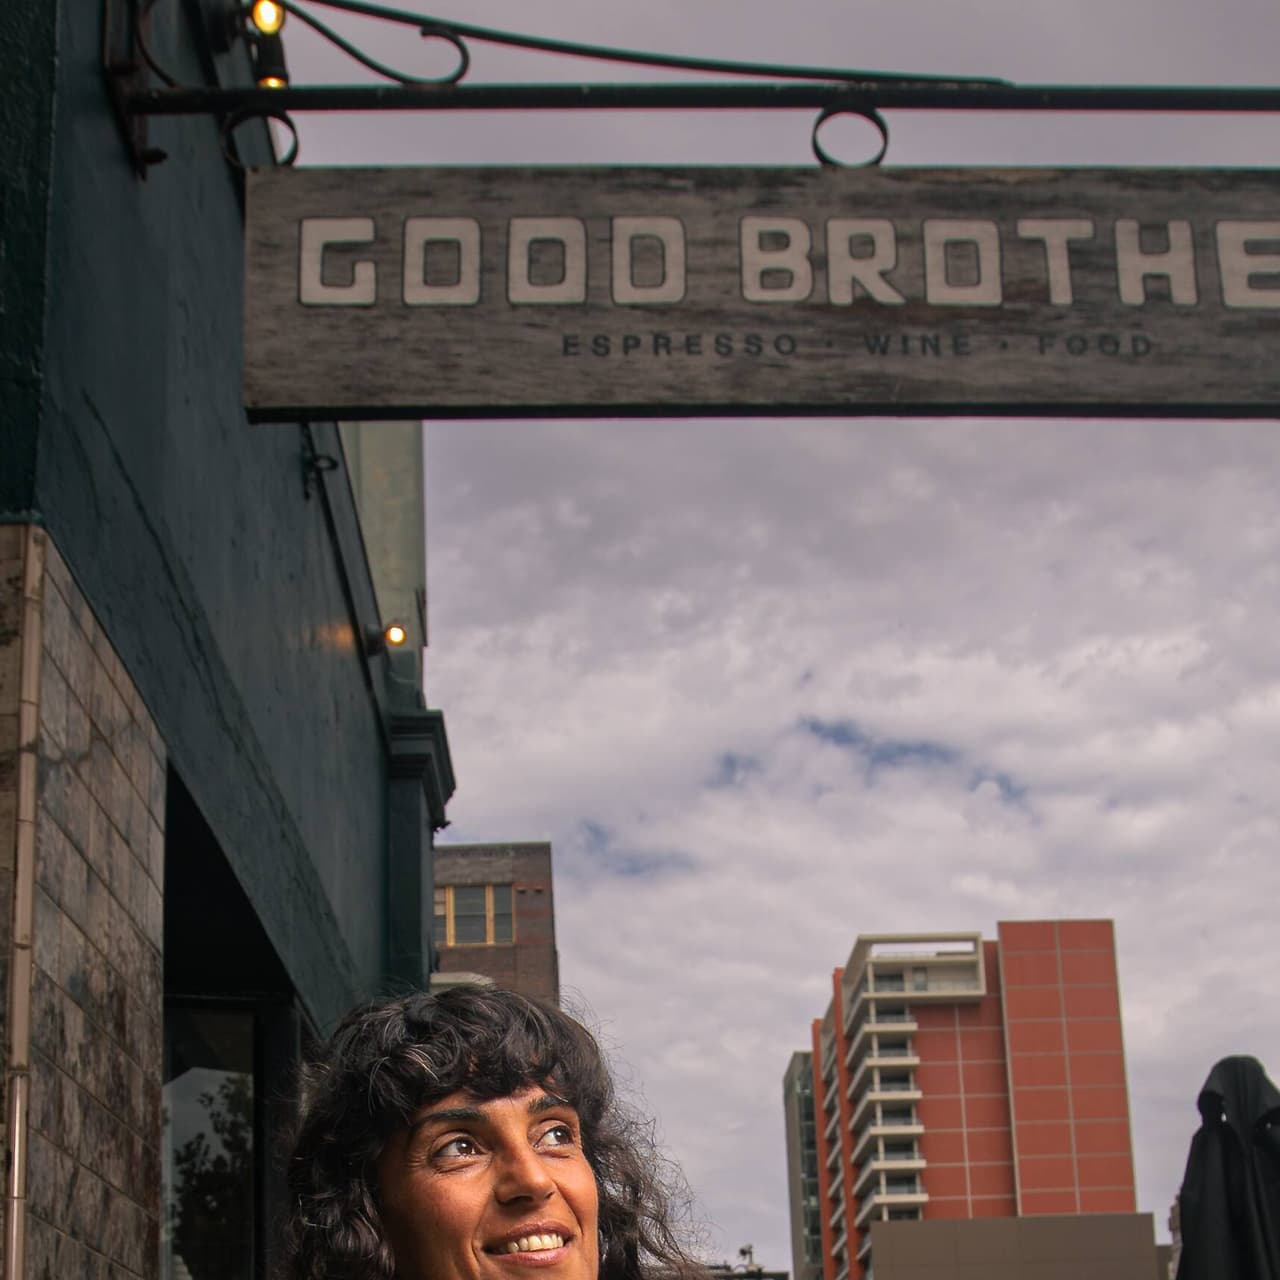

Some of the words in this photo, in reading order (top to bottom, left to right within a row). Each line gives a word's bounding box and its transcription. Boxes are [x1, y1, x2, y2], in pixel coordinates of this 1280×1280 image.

[300, 217, 685, 306] GOOD
[562, 333, 798, 356] ESPRESSO
[863, 333, 973, 356] WINE
[1038, 333, 1153, 356] FOOD
